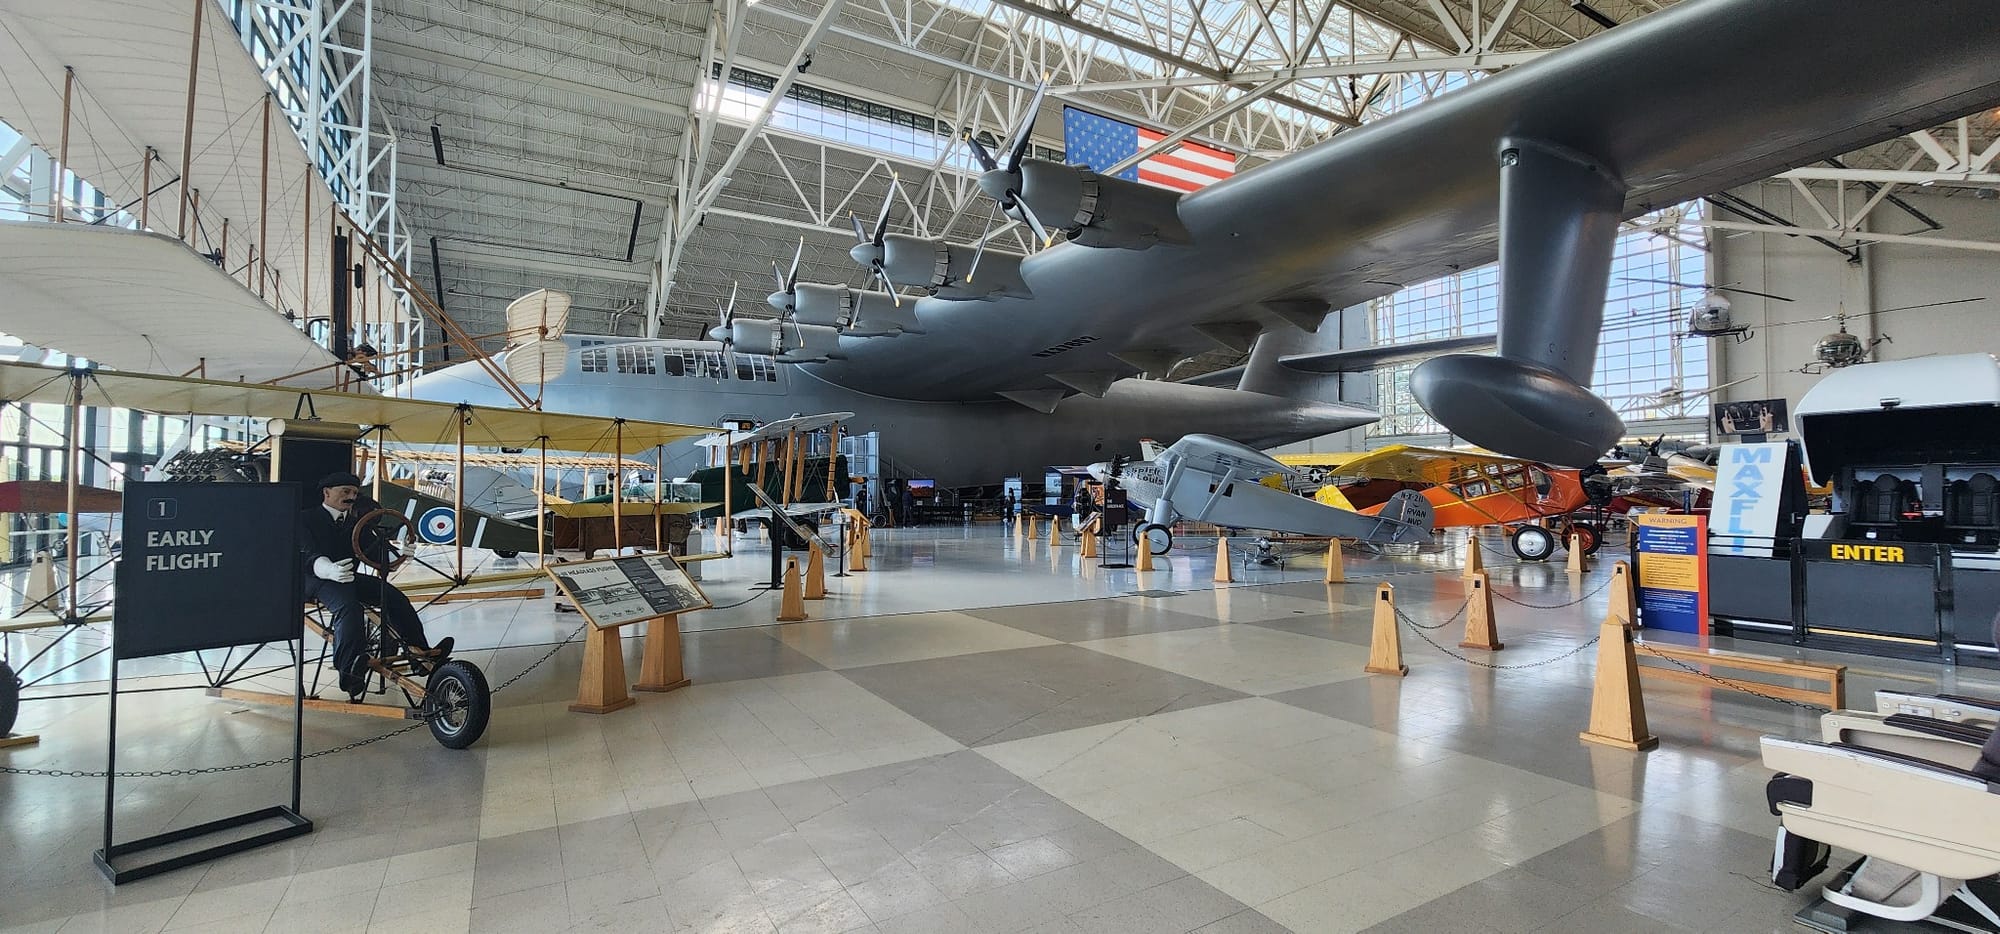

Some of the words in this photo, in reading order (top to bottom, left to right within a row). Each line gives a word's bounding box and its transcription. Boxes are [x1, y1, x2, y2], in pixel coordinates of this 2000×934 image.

[1137, 474, 1164, 485] Louis
[159, 502, 166, 516] 1
[1648, 517, 1688, 526] WARNING
[147, 530, 214, 547] EARLY
[1831, 543, 1905, 563] ENTER
[146, 552, 223, 571] FLIGHT
